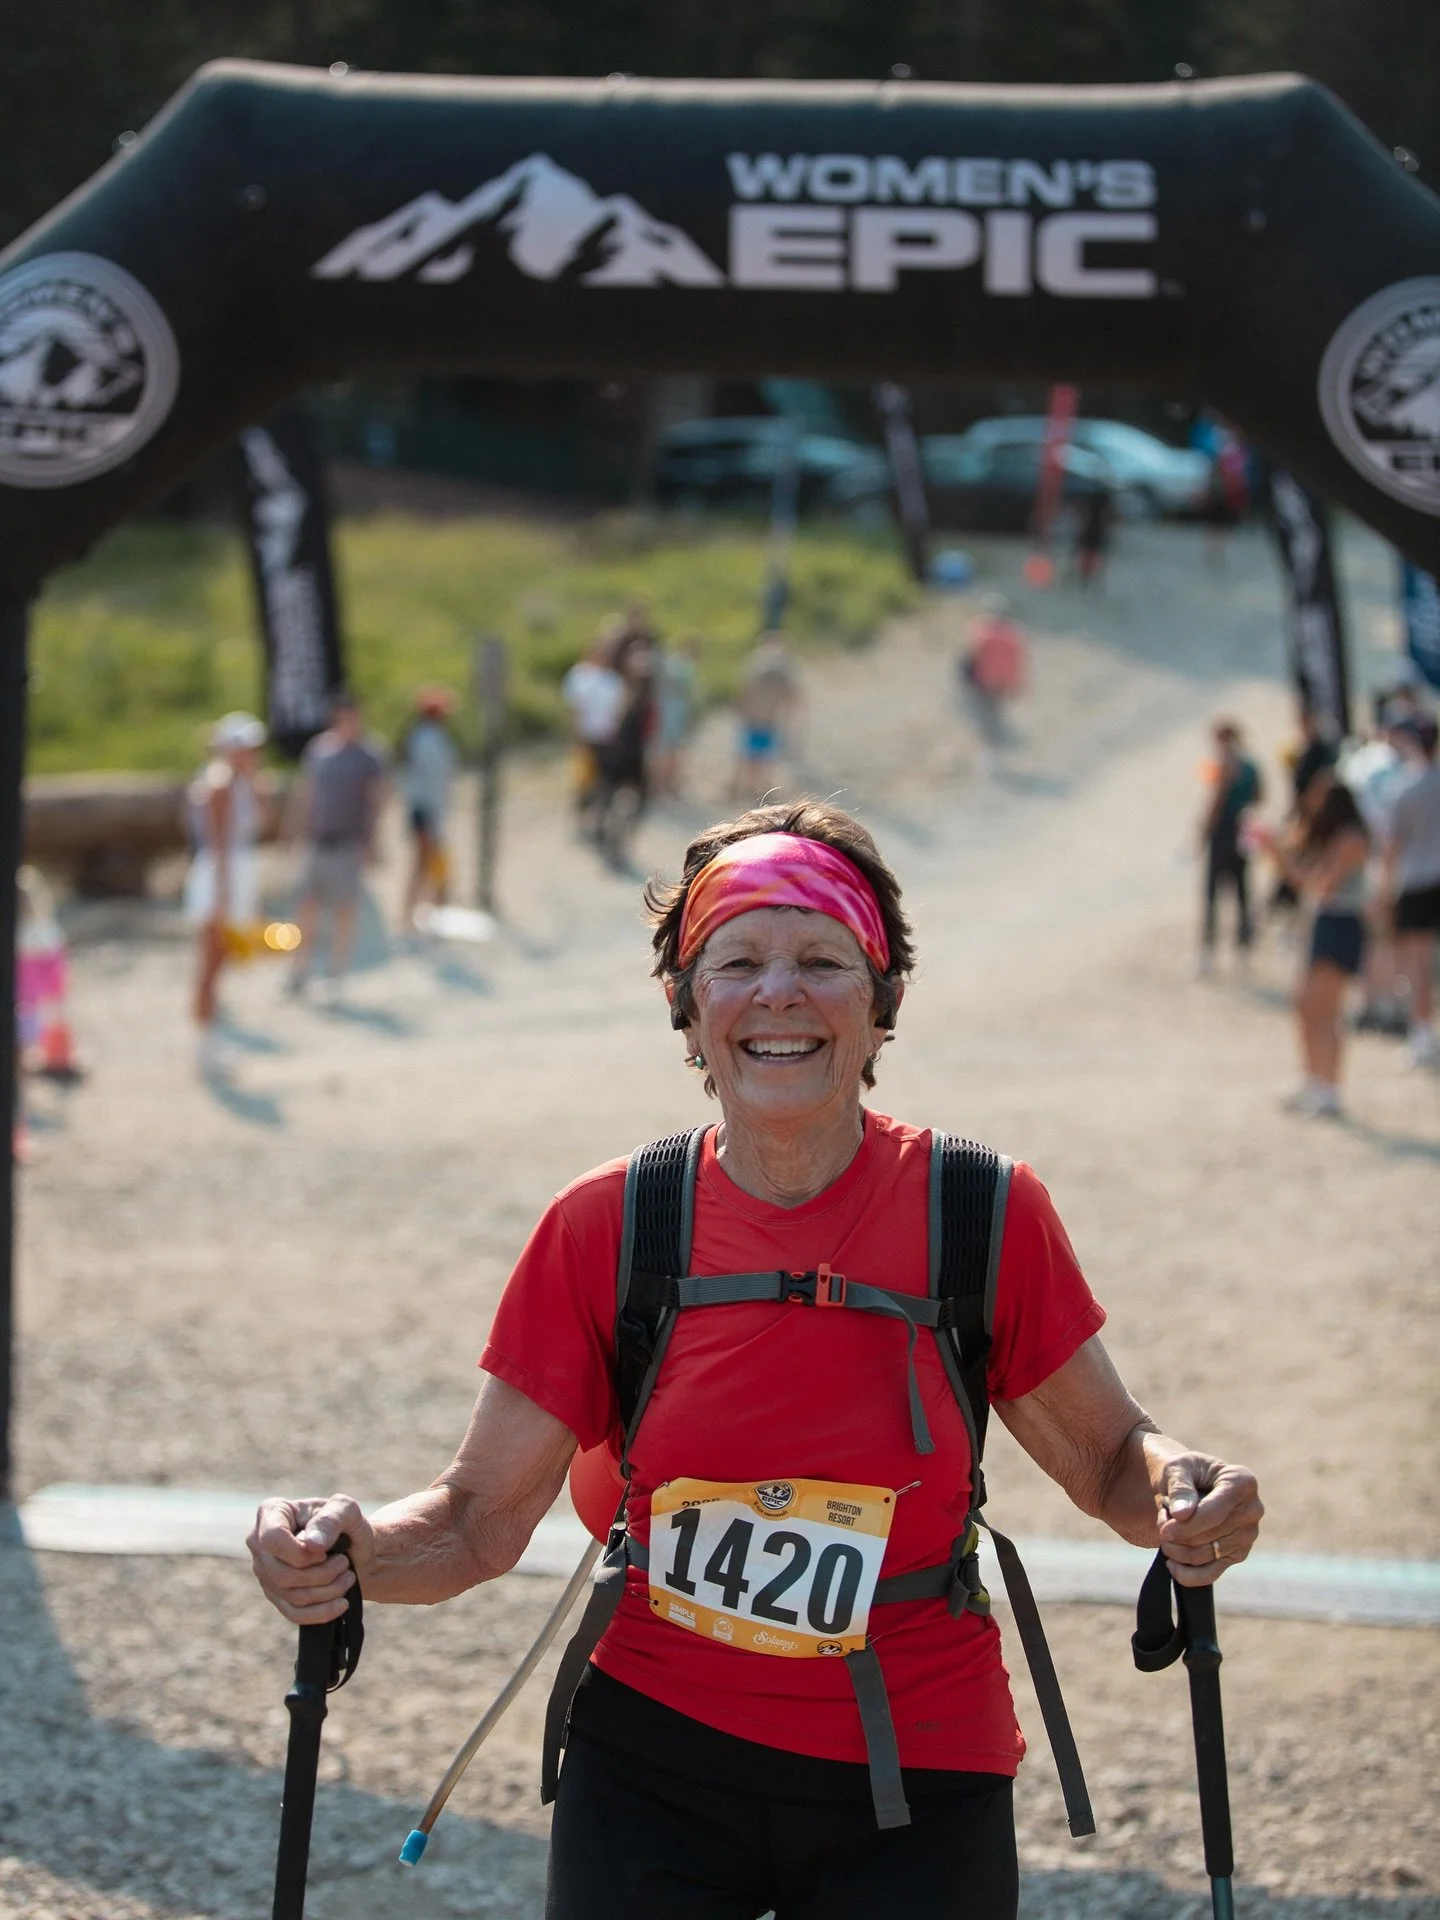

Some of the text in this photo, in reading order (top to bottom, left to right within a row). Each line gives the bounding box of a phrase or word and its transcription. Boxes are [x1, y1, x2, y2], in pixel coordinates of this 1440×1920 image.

[726, 153, 1157, 208] WOMEN'S
[729, 203, 1158, 298] EPIC
[761, 1496, 784, 1506] EPIC
[826, 1499, 863, 1517] BRIGHTON
[827, 1511, 857, 1527] RESORT
[665, 1507, 864, 1636] 1420
[668, 1602, 697, 1620] SIMPLE
[752, 1630, 799, 1651] Solaray
